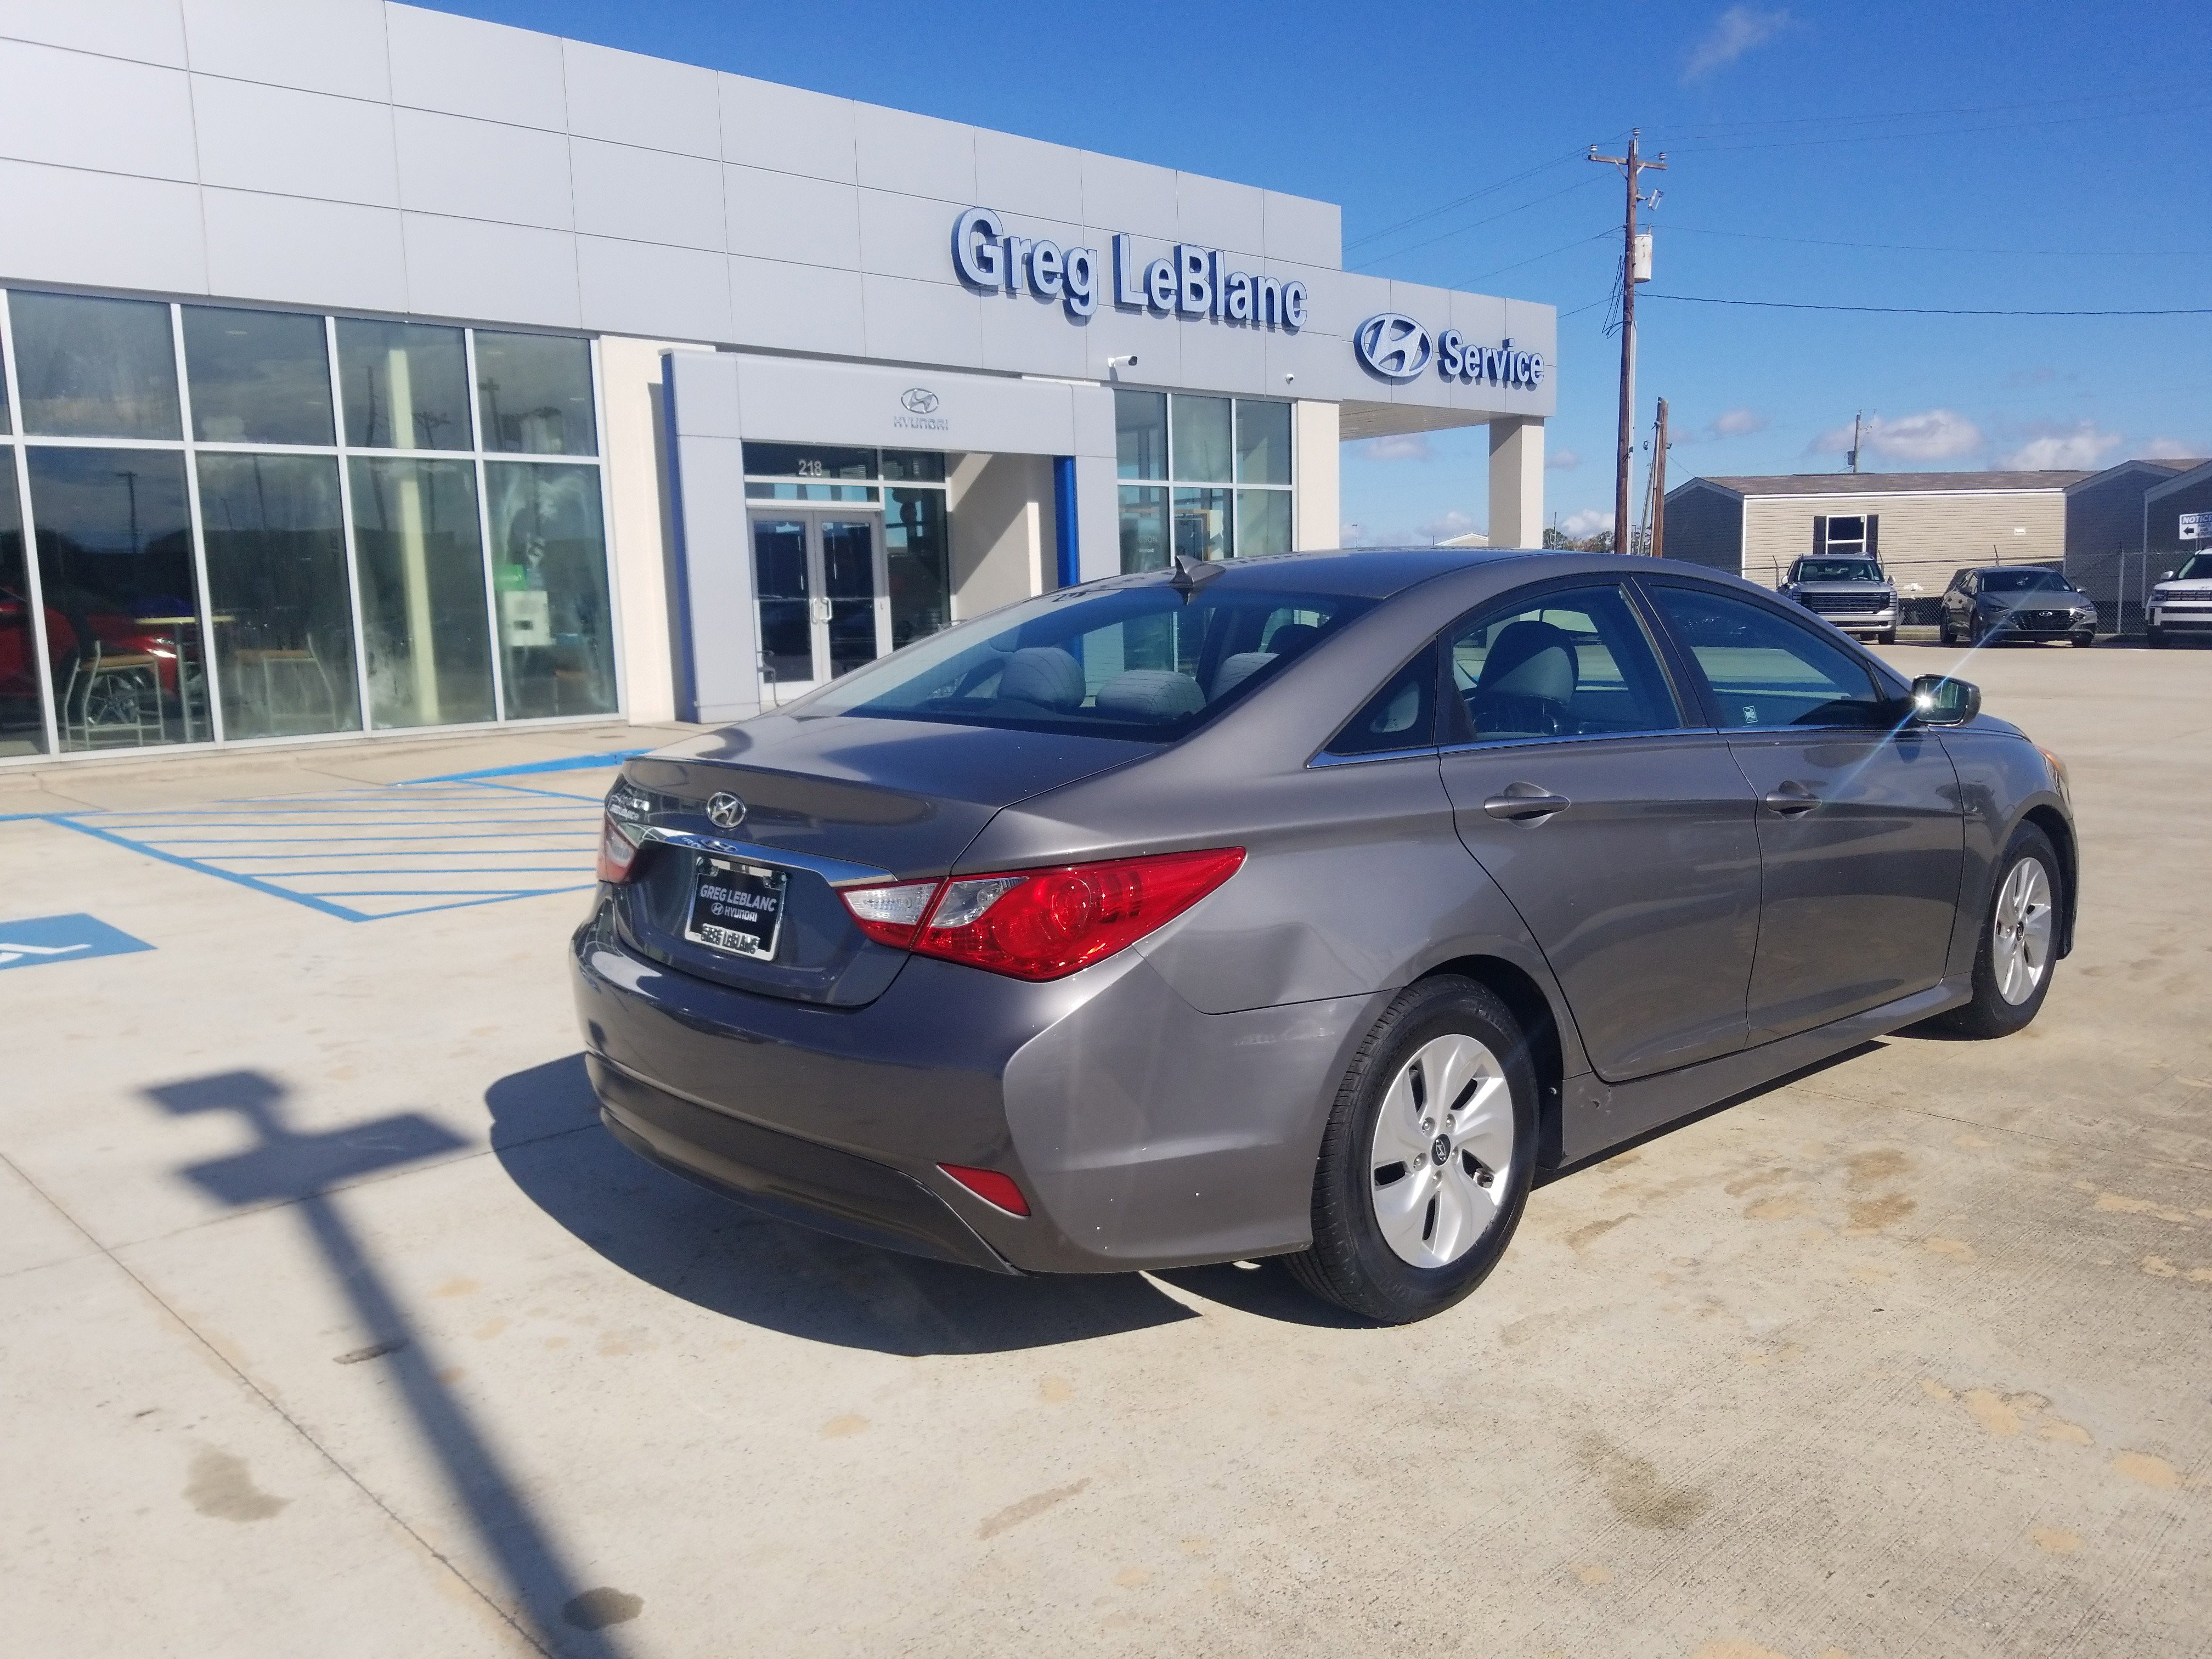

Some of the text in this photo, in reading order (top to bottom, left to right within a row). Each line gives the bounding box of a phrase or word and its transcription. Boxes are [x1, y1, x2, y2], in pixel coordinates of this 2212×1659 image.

[951, 207, 1308, 327] Greg LeBlanc
[1437, 329, 1545, 385] Service
[798, 460, 822, 476] 218
[700, 884, 777, 912] GREG LEBLANC
[724, 906, 758, 923] HYUNDAI
